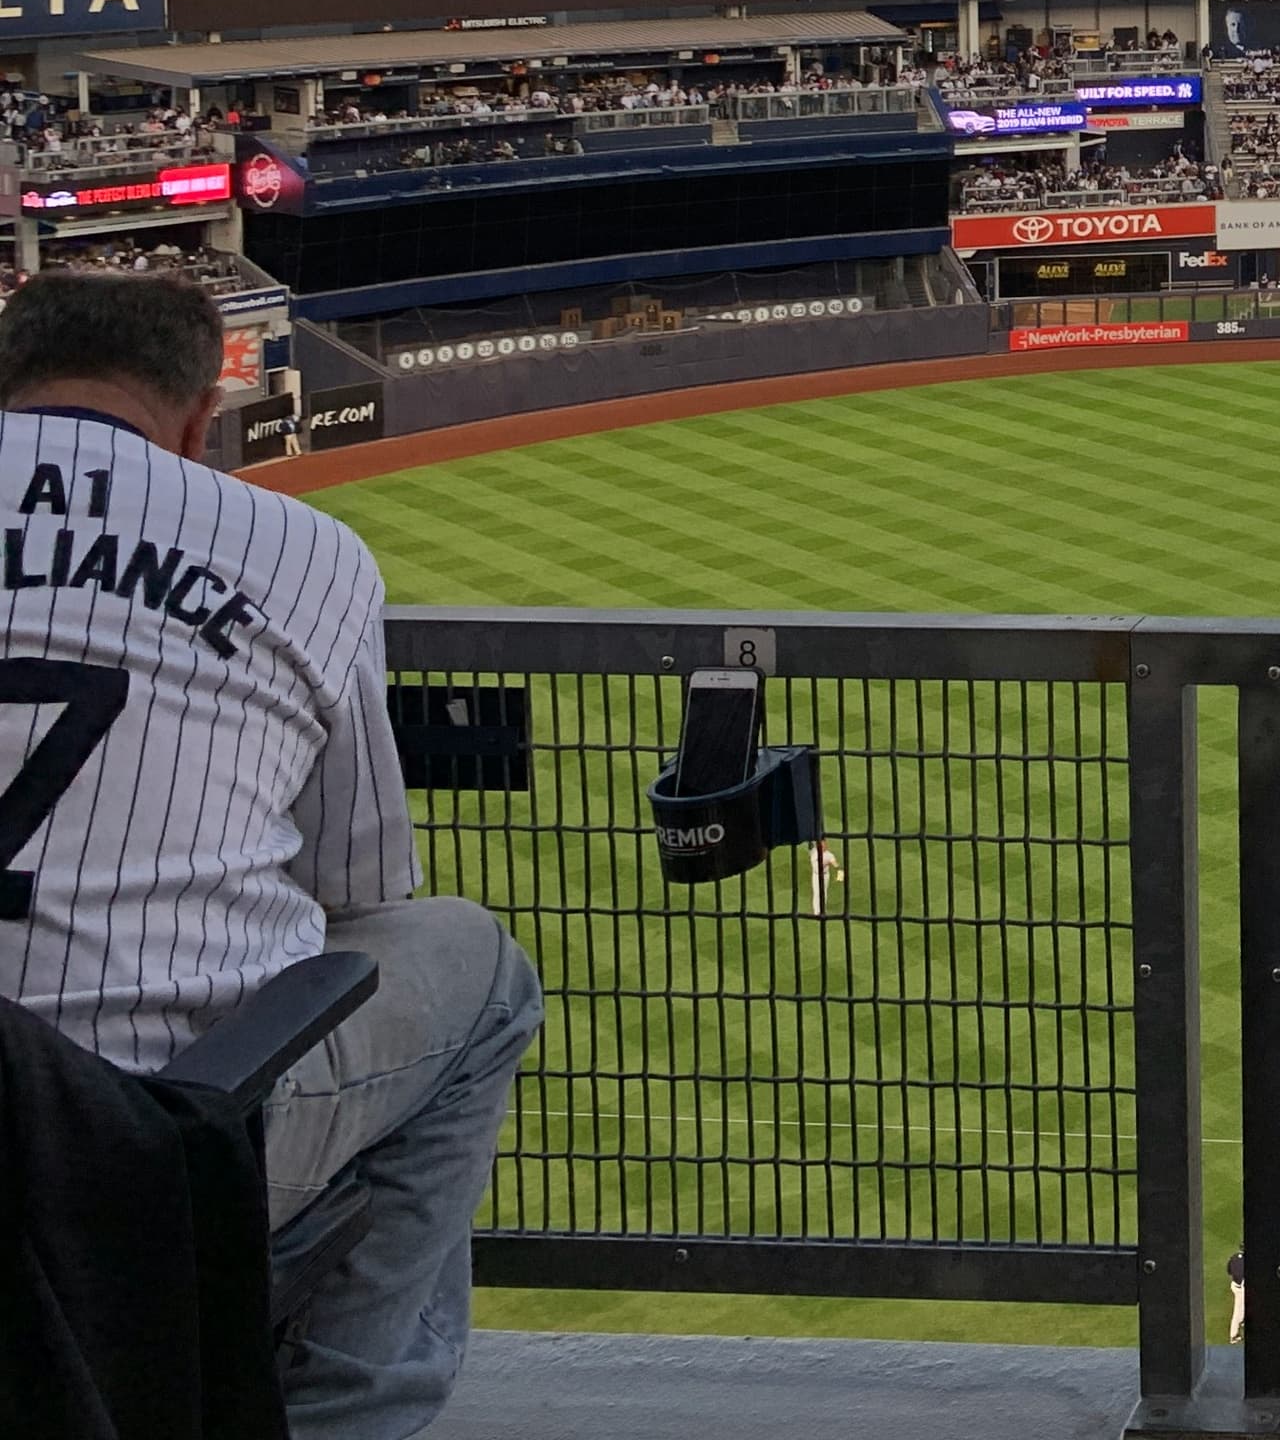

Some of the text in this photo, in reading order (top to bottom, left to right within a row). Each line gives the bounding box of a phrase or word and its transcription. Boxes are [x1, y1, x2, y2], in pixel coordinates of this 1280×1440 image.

[462, 16, 547, 29] MITSUBISHI ELECTRIC
[1107, 85, 1176, 99] FOR SPEED.
[997, 107, 1062, 119] THE ALL-NEW
[1047, 115, 1084, 126] HYBRID
[1131, 114, 1184, 126] TERRACE
[1056, 213, 1162, 238] TOYOTA
[1220, 221, 1250, 230] BANK
[1252, 221, 1265, 229] OF
[1179, 251, 1227, 267] FedEx
[565, 336, 575, 344] 15
[1029, 326, 1181, 346] NewYork-Presbyterian
[739, 640, 757, 667] 8
